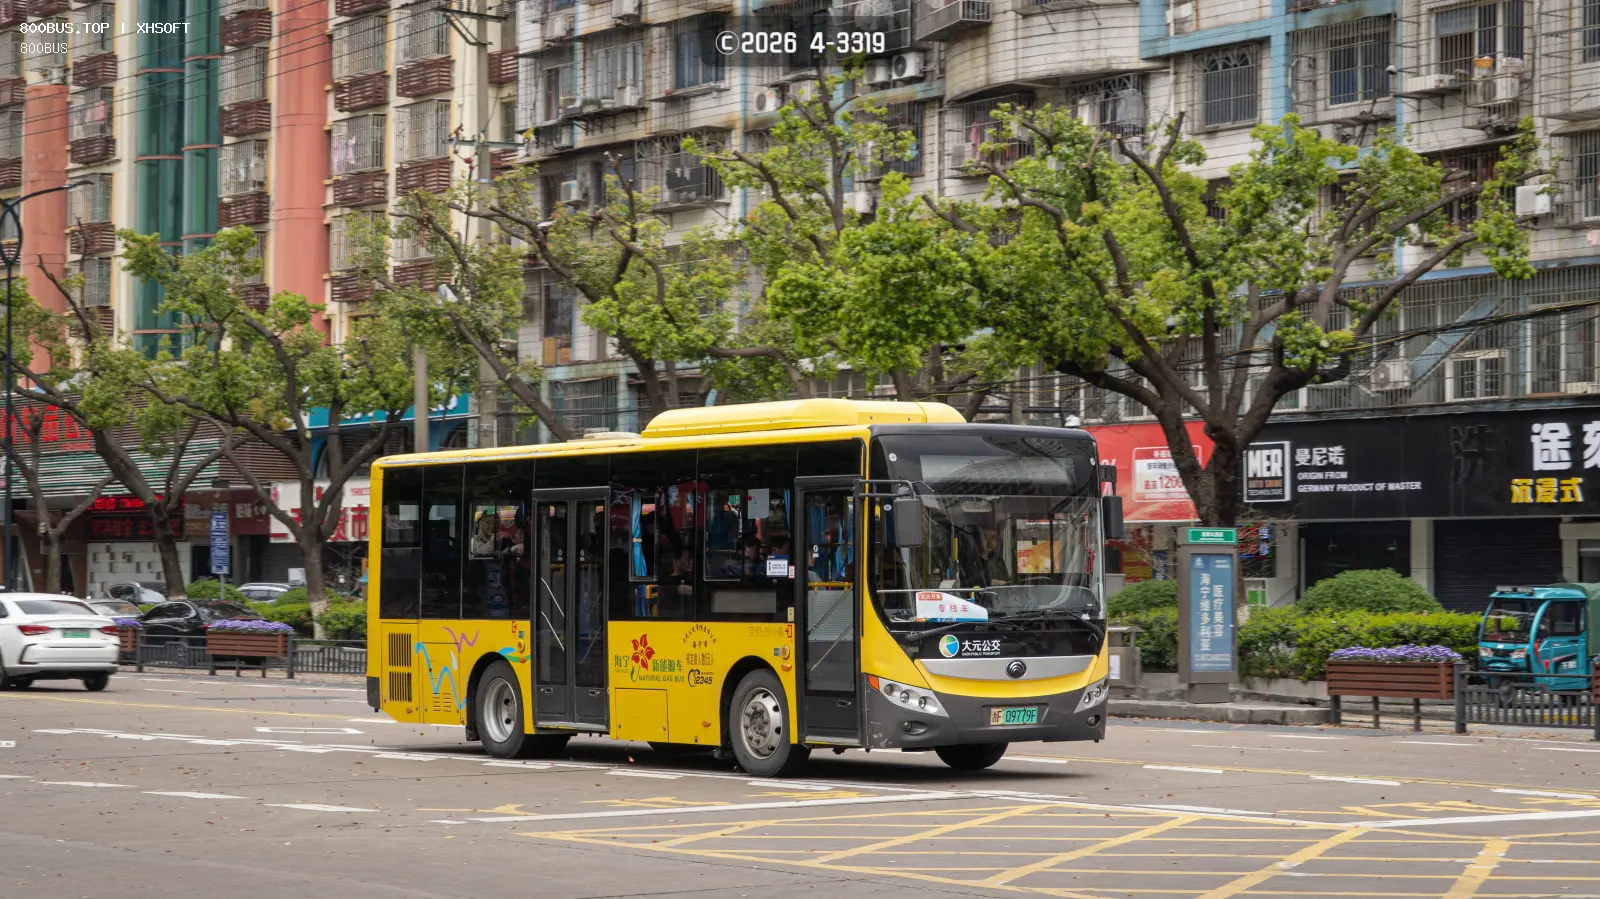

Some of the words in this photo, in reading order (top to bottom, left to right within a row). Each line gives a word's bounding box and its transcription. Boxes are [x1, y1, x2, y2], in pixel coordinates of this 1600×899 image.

[1294, 446, 1345, 467] 曼尼诺
[1247, 449, 1283, 478] MER
[1297, 471, 1324, 480] ORIGIN
[1325, 471, 1348, 480] FROM
[1297, 484, 1335, 493] GERMANY
[1336, 483, 1374, 492] PRODUCT
[1375, 482, 1387, 491] OF
[1388, 482, 1422, 491] MASTER
[1510, 477, 1584, 504] 沉浸式
[961, 640, 1001, 652] 大元公交
[652, 659, 684, 673] 新能源车
[674, 675, 685, 683] BUS
[693, 676, 713, 685] 12345
[1005, 709, 1036, 723] 09779F
